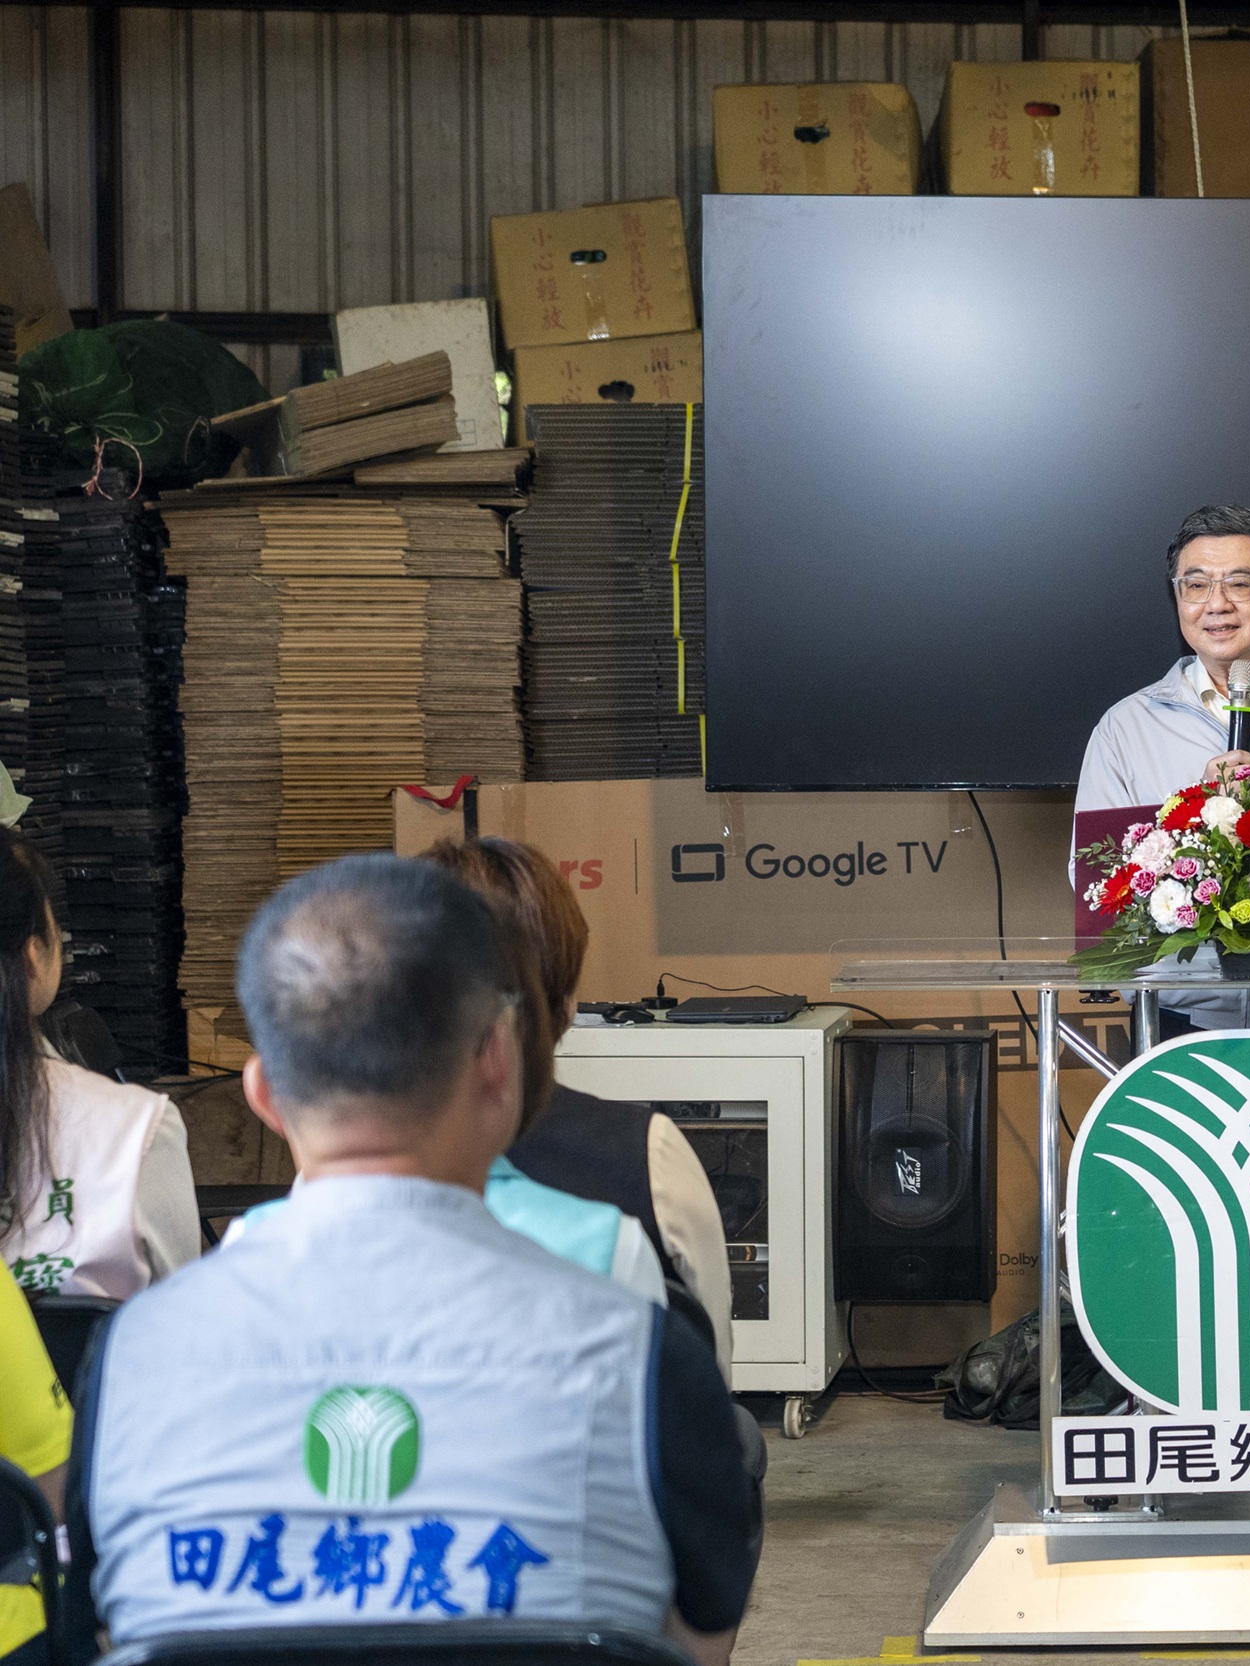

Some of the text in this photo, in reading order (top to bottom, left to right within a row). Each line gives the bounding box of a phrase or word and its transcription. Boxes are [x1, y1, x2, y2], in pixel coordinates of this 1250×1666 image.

[989, 75, 1013, 181] 小心輕放
[532, 226, 566, 332] 小心輕放
[745, 840, 949, 887] Google TV
[914, 1161, 922, 1189] audio
[996, 1268, 1026, 1277] AUDIO
[999, 1252, 1040, 1269] Dolby
[165, 1511, 550, 1617] 田尾鄉農會
